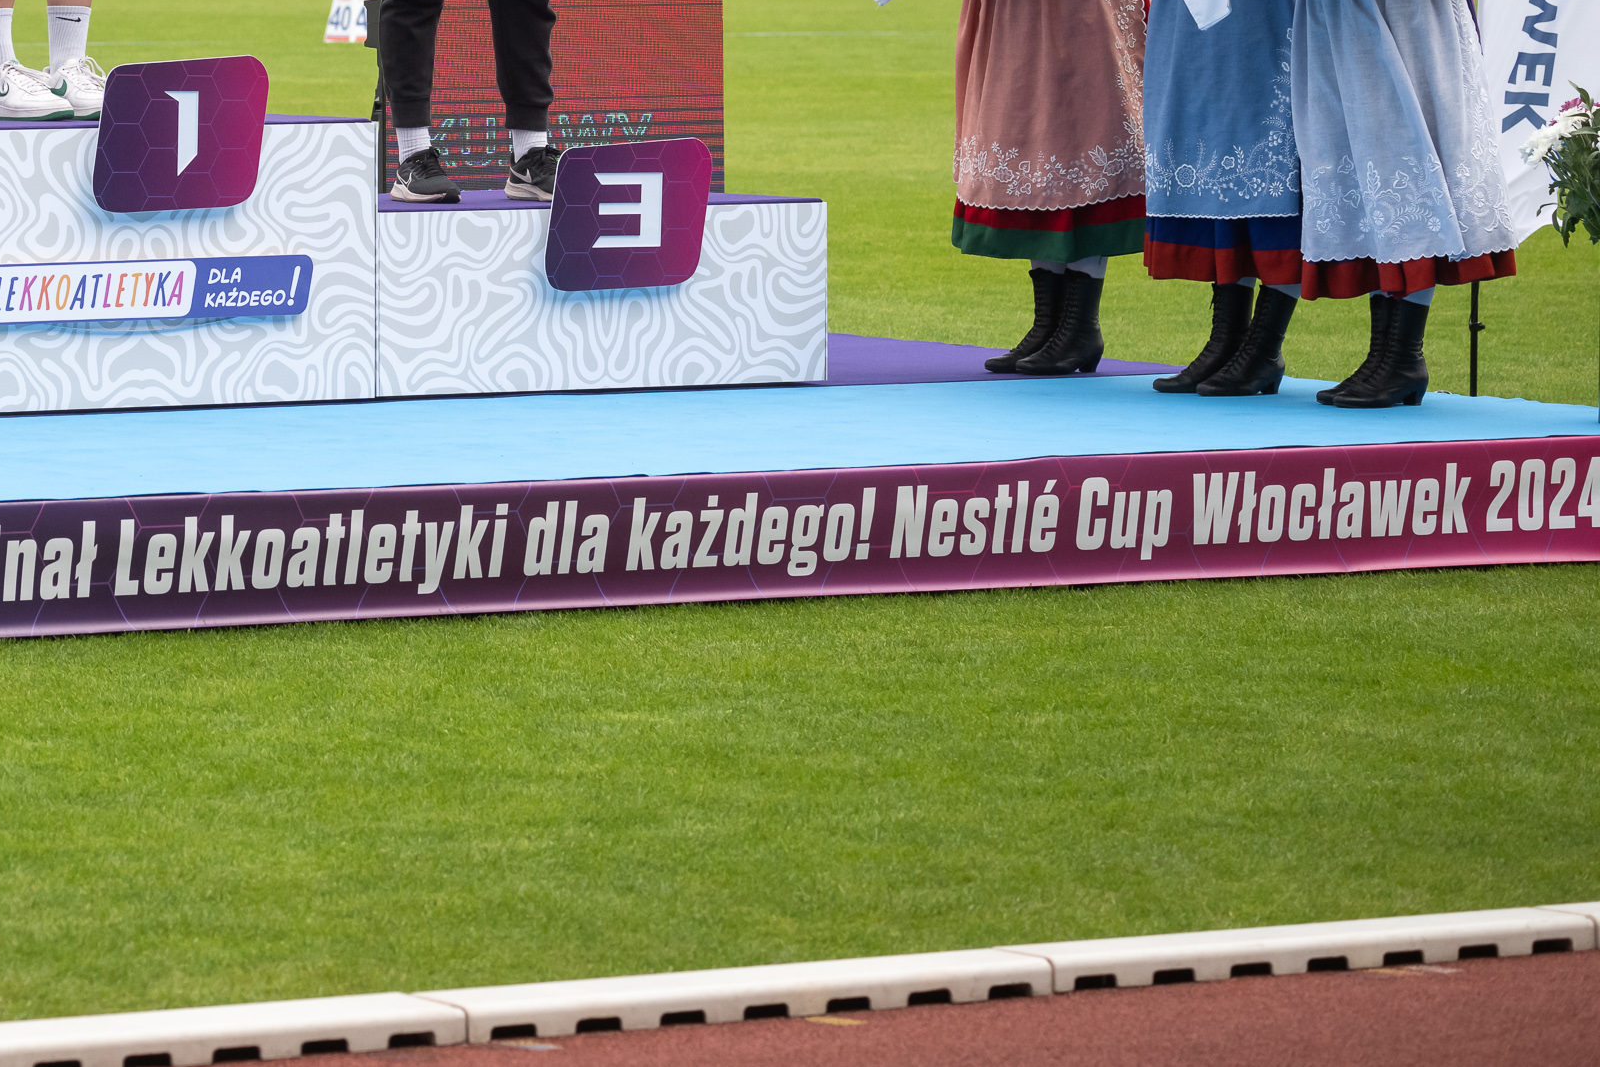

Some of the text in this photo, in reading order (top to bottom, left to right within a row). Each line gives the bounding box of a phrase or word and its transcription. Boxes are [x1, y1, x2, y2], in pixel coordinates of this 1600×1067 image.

[165, 89, 200, 177] 1
[592, 172, 663, 248] 3
[207, 267, 242, 285] DLA
[114, 501, 507, 596] Lekkoatletyki
[524, 501, 606, 576] dla
[625, 486, 875, 577] każdego!
[890, 478, 1059, 561] Nestlé
[1076, 476, 1173, 561] Cup
[1192, 462, 1470, 547] Włocławek
[1486, 456, 1600, 532] 2024
